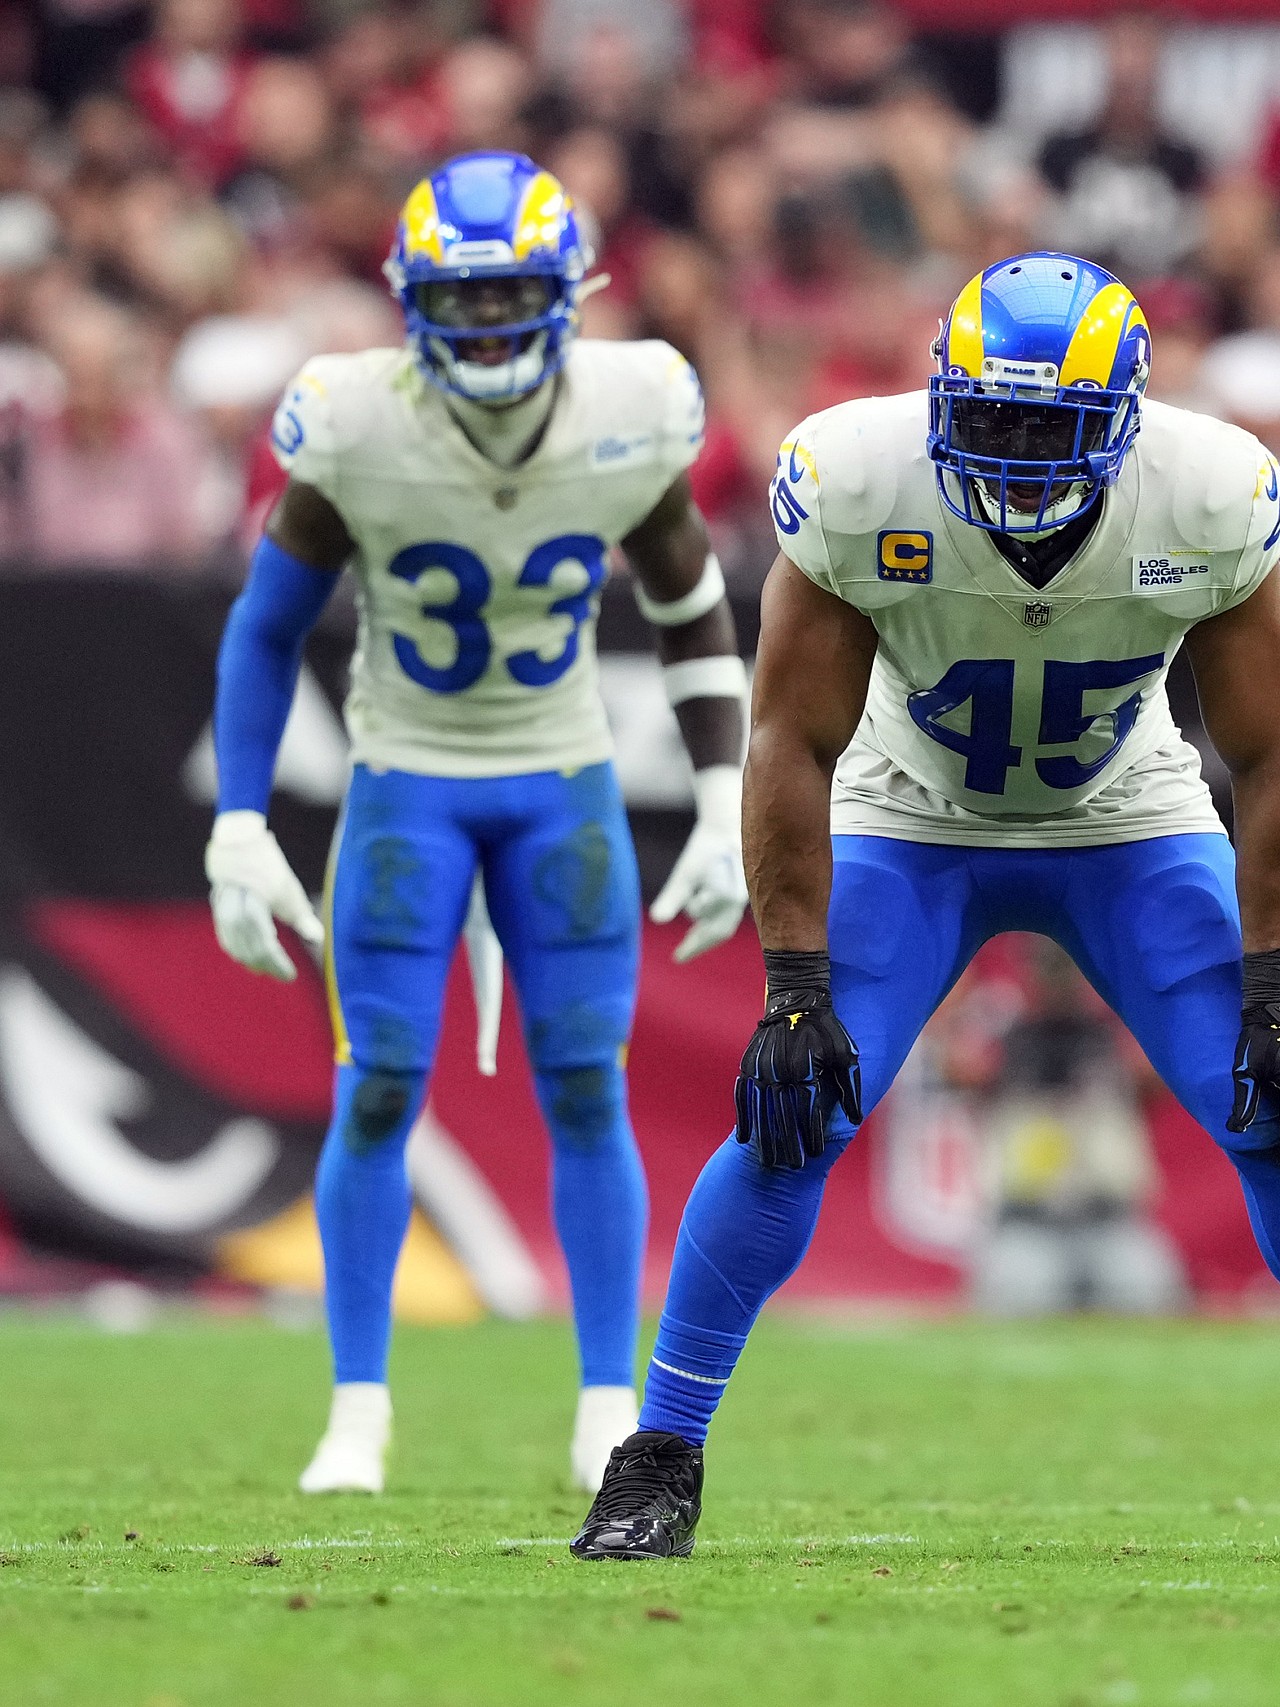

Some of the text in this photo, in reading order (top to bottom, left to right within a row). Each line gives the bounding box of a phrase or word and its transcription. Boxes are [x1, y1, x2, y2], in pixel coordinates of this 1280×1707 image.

[881, 533, 929, 570] C
[1139, 559, 1170, 569] LOS
[1139, 565, 1209, 578] ANGELES
[1139, 576, 1183, 586] RAMS
[386, 534, 606, 694] 33
[1026, 613, 1048, 625] NFL
[906, 651, 1166, 796] 45
